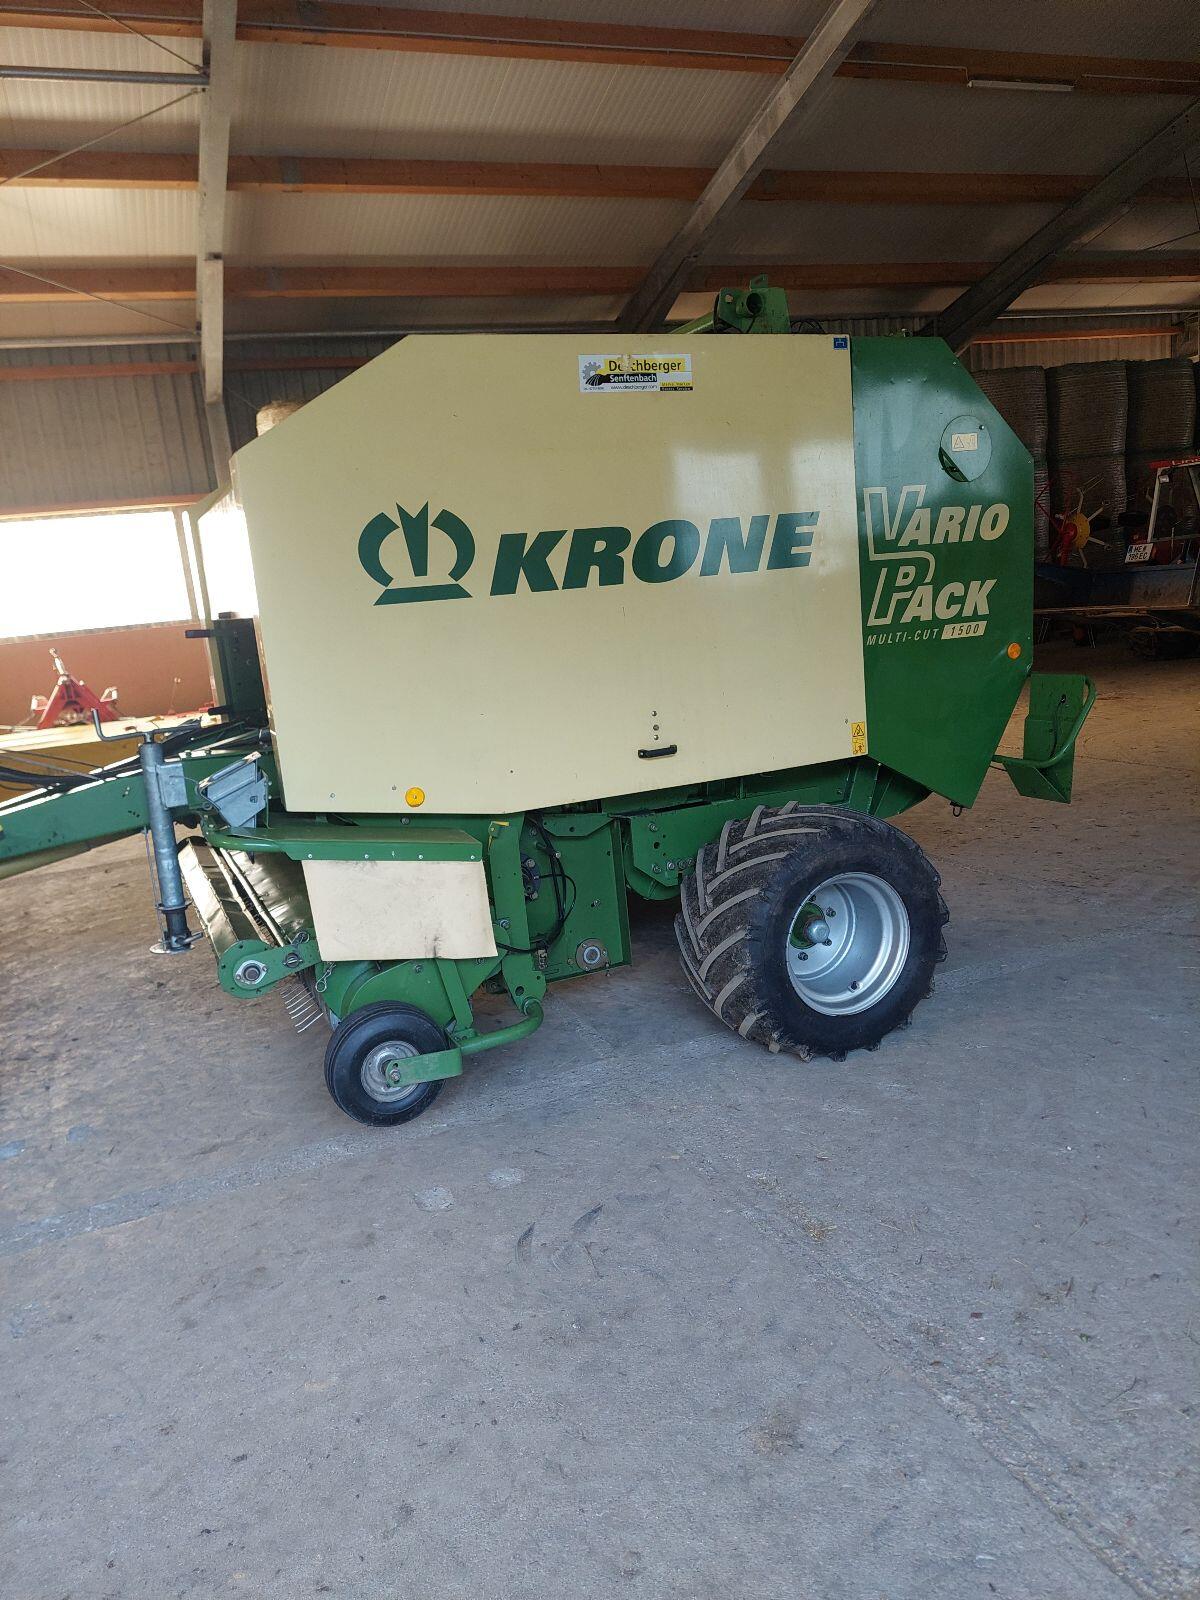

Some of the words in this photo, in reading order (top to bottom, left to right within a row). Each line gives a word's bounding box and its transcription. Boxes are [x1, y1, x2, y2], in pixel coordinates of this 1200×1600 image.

[609, 374, 657, 383] Senftenbach
[863, 484, 1010, 547] VARIO
[489, 511, 820, 596] KRONE
[867, 551, 997, 626] PACK
[867, 628, 939, 646] MULTI-CUT
[951, 623, 980, 637] 1500
